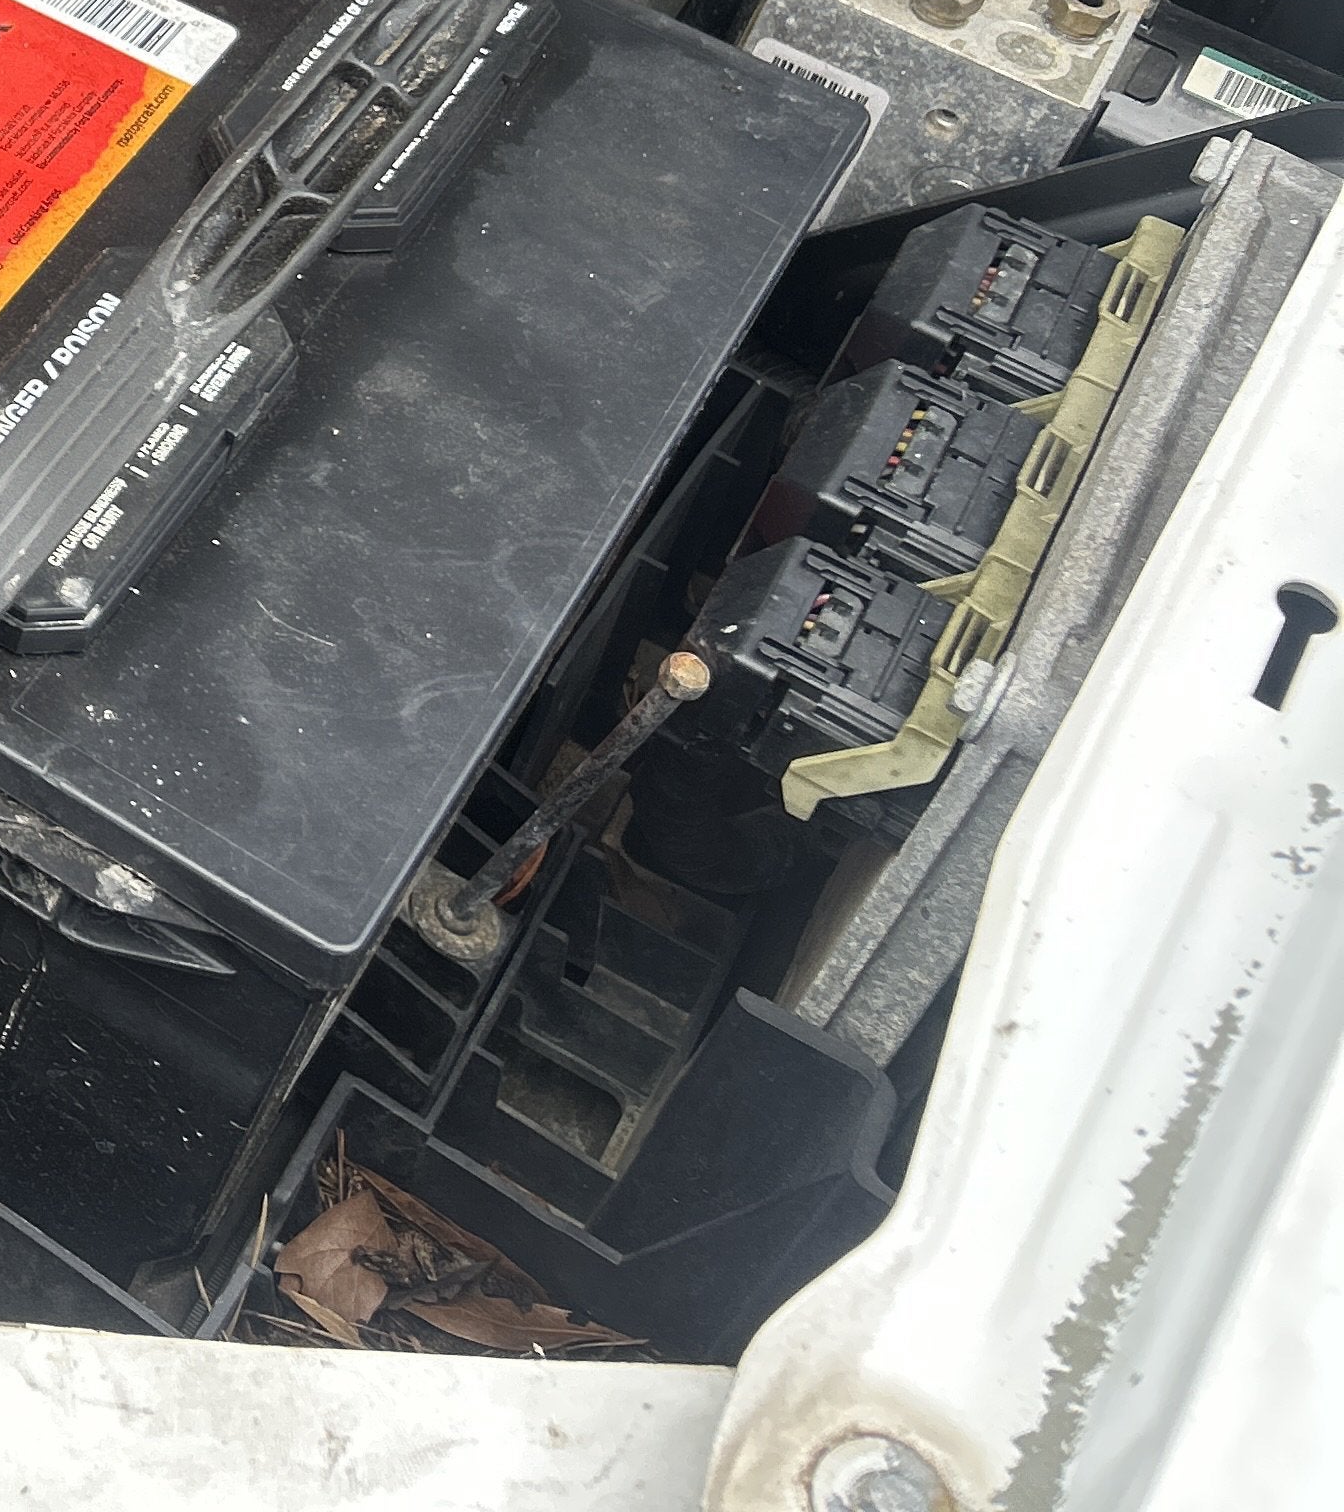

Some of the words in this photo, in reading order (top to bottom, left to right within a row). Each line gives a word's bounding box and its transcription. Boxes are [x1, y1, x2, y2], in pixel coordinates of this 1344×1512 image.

[297, 58, 313, 73] OUT
[309, 48, 322, 59] OF
[317, 34, 336, 48] THE
[347, 3, 361, 15] OF
[496, 3, 528, 34] RECYCLE
[113, 82, 176, 148] motorcraft.com
[7, 229, 27, 246] Cold
[18, 204, 50, 234] Cranking
[48, 545, 72, 566] CAN
[62, 520, 92, 548] CAUSE
[83, 533, 103, 549] OR
